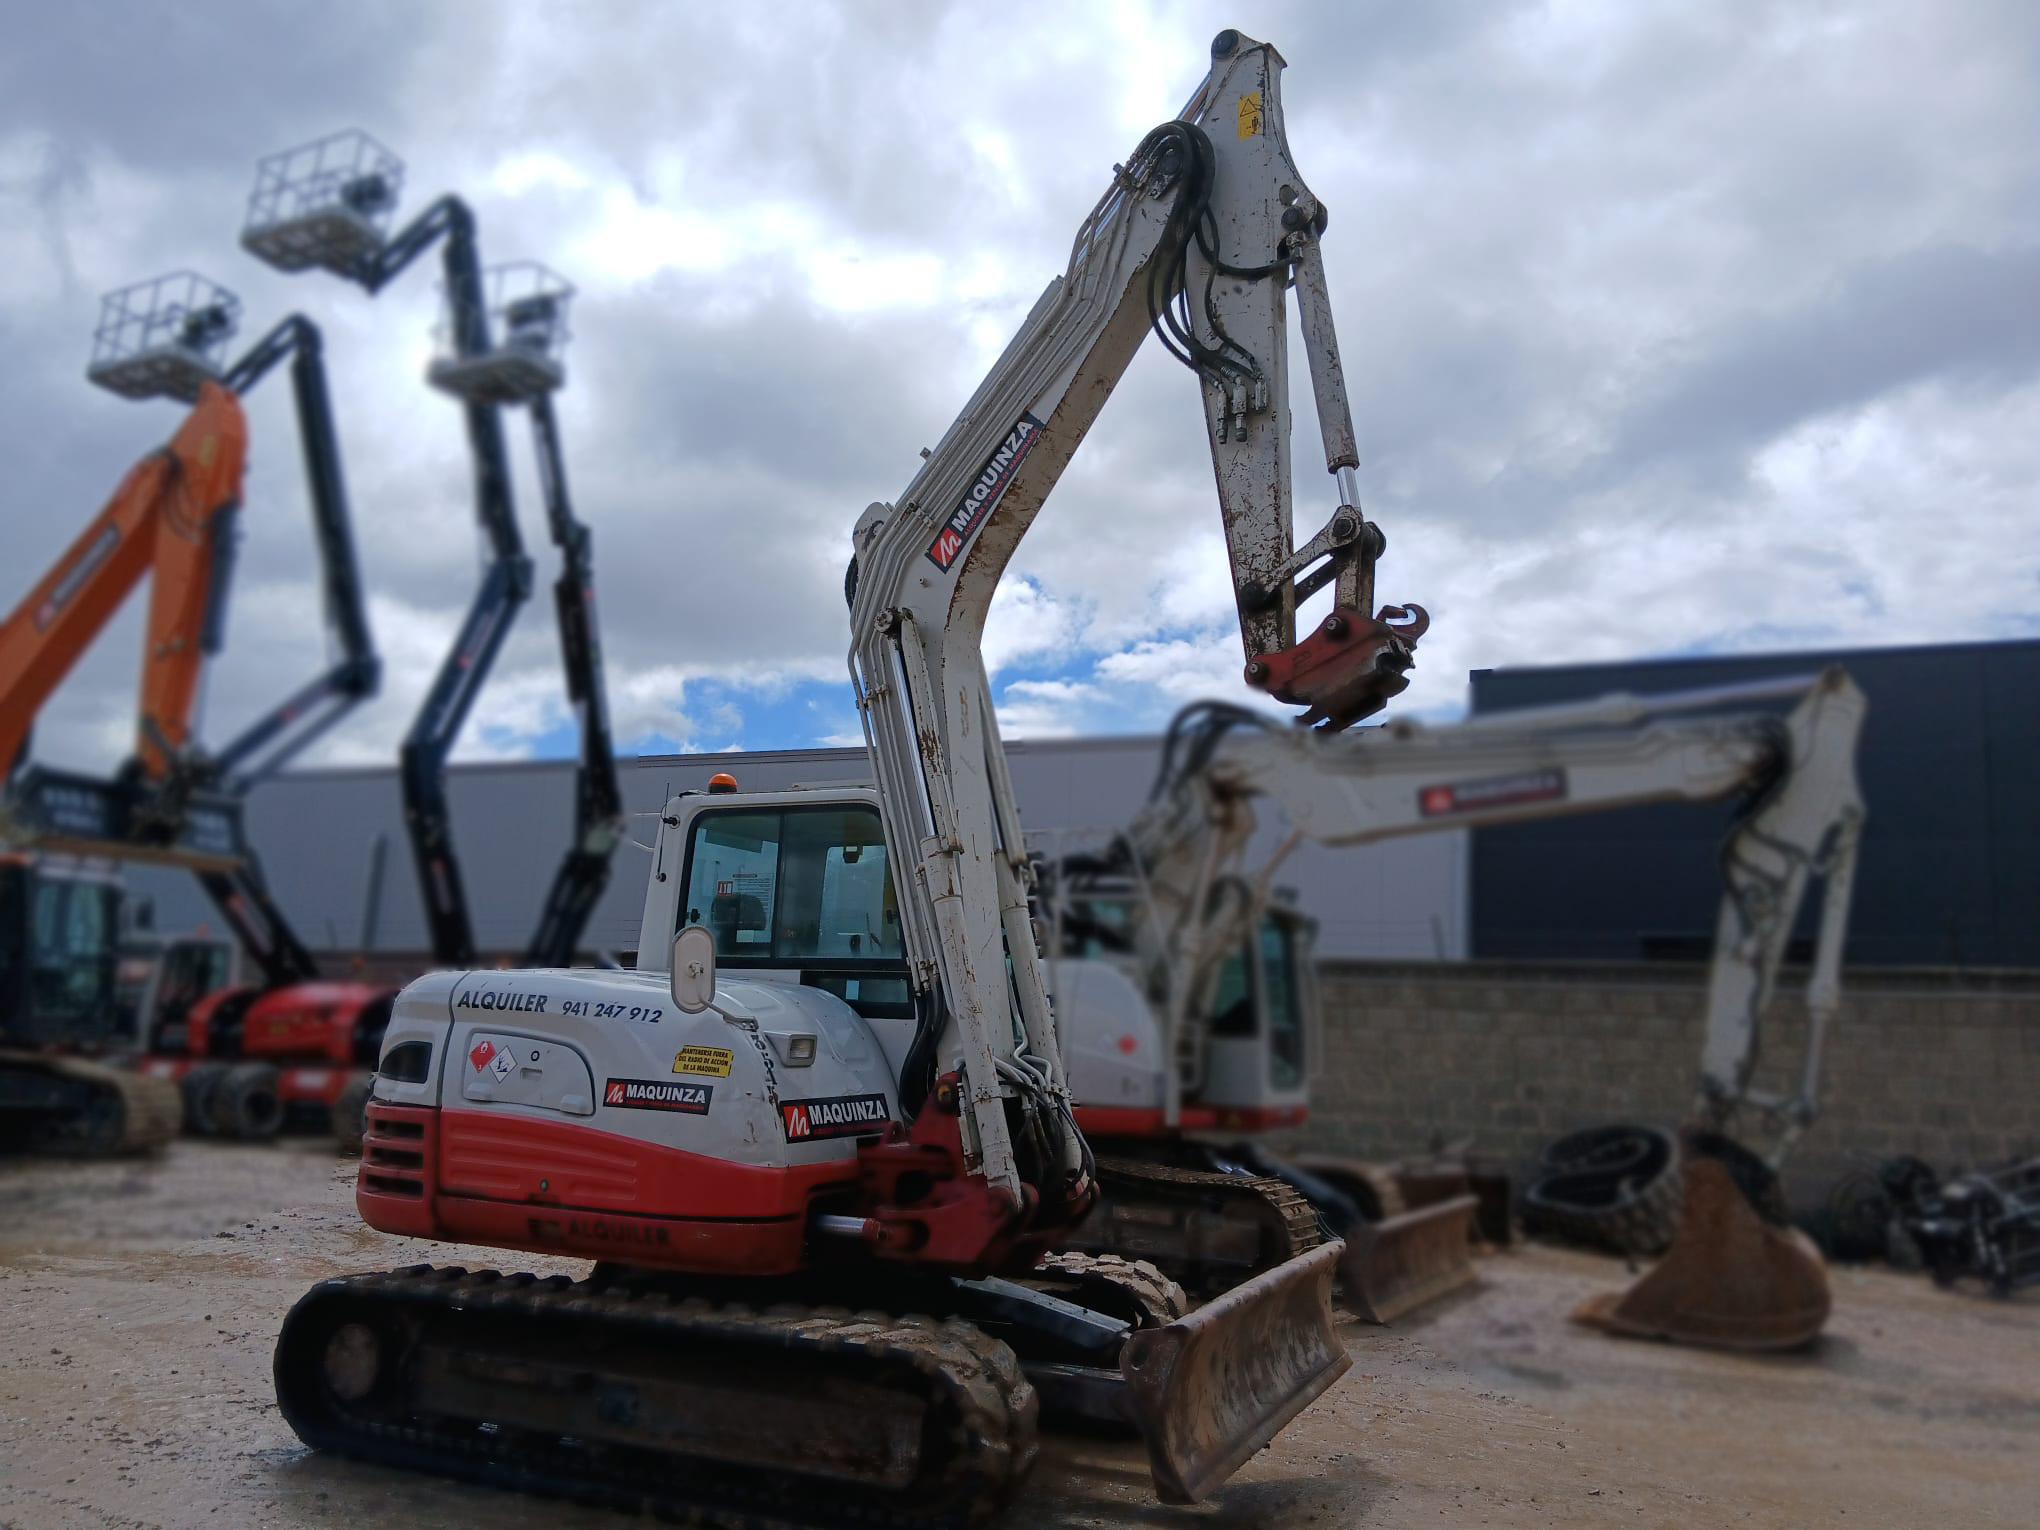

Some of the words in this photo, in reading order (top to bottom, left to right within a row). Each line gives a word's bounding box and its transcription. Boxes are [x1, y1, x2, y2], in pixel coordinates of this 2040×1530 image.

[951, 421, 1034, 531] MAQUINZA
[457, 991, 548, 1012] ALQUILER
[562, 1000, 588, 1017] 941
[593, 1003, 626, 1018] 247
[629, 1007, 663, 1023] 912
[626, 1084, 706, 1103] MAQUINZA
[808, 1100, 887, 1125] MAQUINZA
[568, 1217, 670, 1245] ALQUILER
